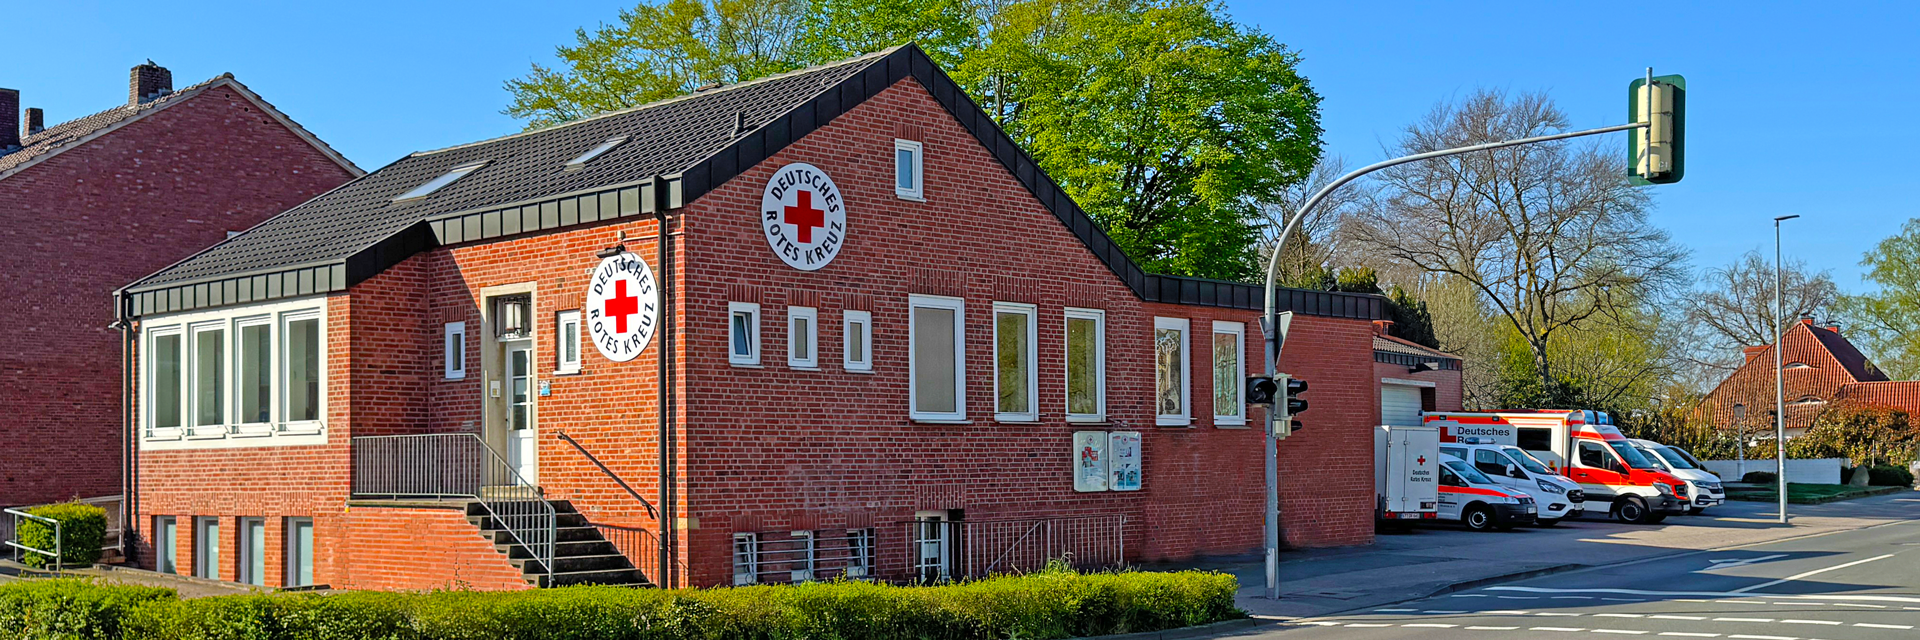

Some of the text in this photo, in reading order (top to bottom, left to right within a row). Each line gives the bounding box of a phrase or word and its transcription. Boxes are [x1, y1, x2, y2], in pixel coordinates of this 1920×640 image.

[770, 169, 839, 213] DEUTSCHES
[766, 210, 842, 265] ROTES KREUZ
[594, 257, 652, 296] DEUTSCHES
[591, 302, 655, 355] ROTES KREUZ
[1457, 426, 1510, 436] Deutsches
